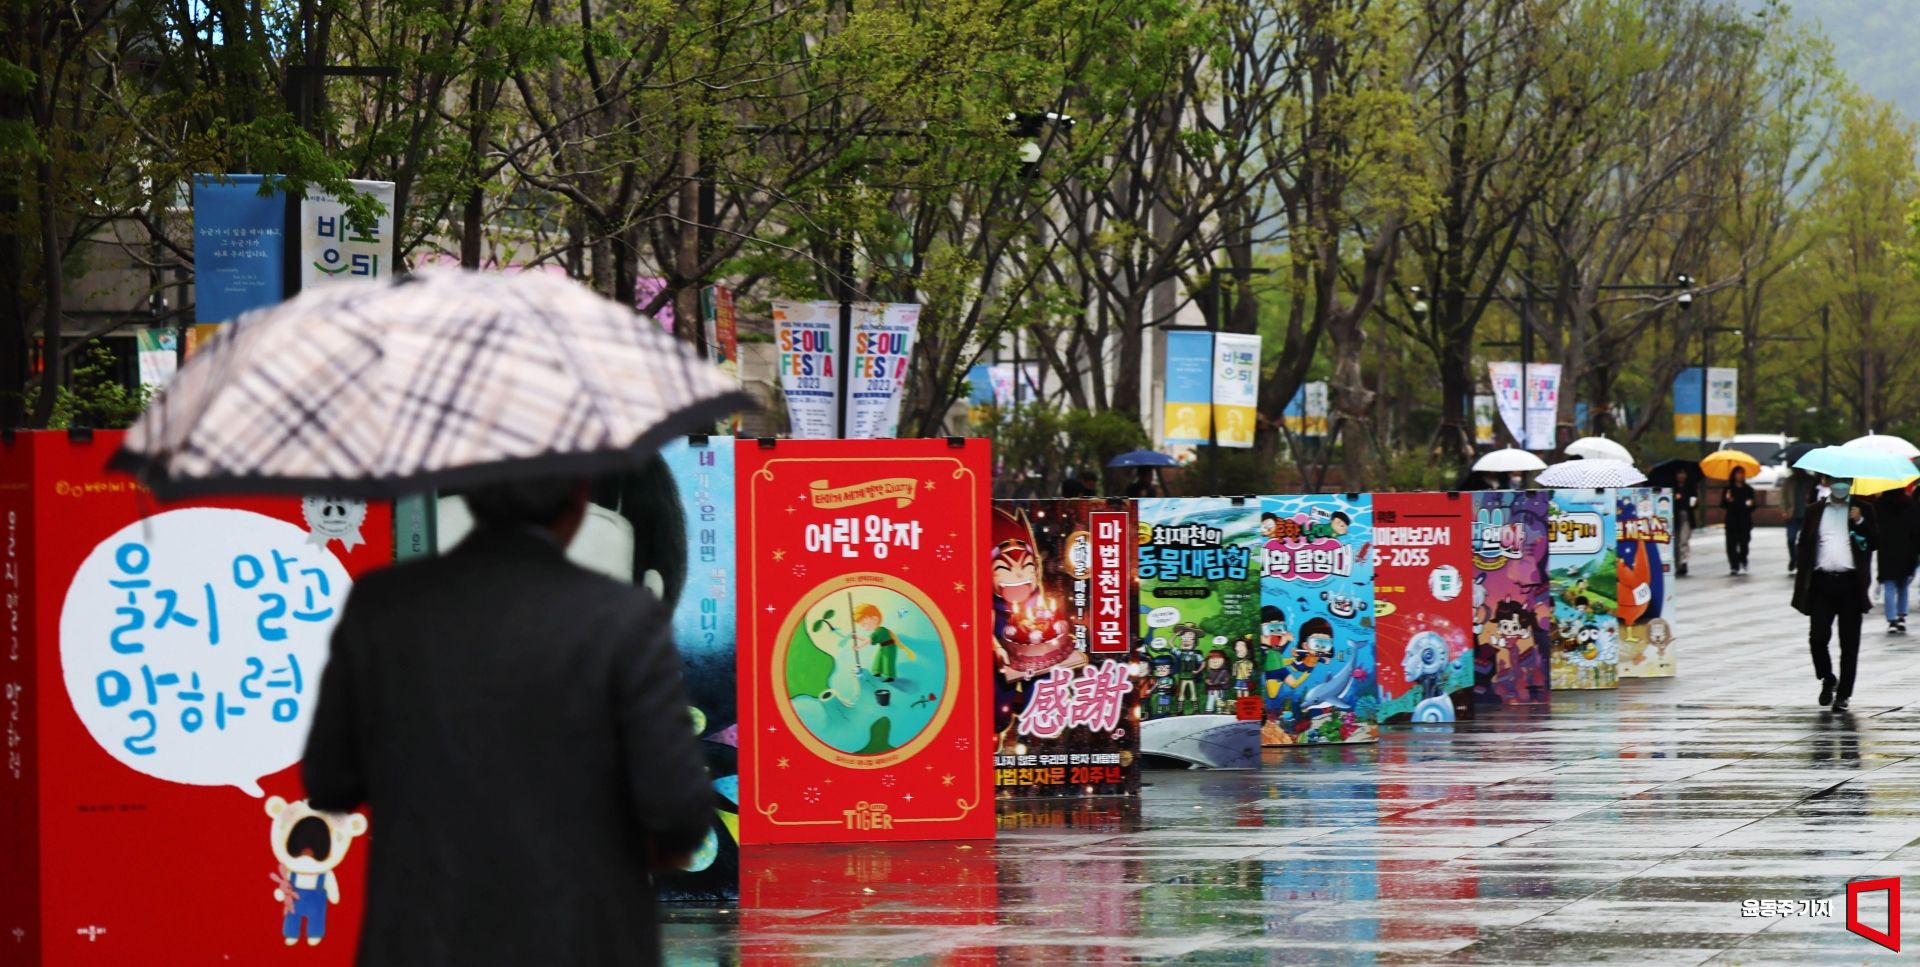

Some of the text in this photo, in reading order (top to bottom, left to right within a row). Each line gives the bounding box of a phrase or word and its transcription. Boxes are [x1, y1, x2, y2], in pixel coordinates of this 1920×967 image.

[780, 329, 833, 353] SEOUL
[856, 333, 909, 356] SEOUL
[781, 353, 833, 378] FESTA
[797, 377, 820, 389] 2023
[867, 379, 890, 391] 2023
[699, 451, 715, 467] 네
[700, 528, 716, 563] 어떤
[804, 514, 923, 559] 어린 왕자
[1153, 525, 1222, 547] 최재천의
[1138, 545, 1249, 581] 동물대탐험
[1294, 545, 1353, 577] 탐험대
[1096, 519, 1123, 645] 마법천자문
[109, 543, 334, 655] 울지 말고
[95, 653, 303, 756] 말하렴
[1019, 660, 1132, 738] 感謝
[1071, 766, 1121, 784] 20주년
[843, 809, 893, 831] TIGER
